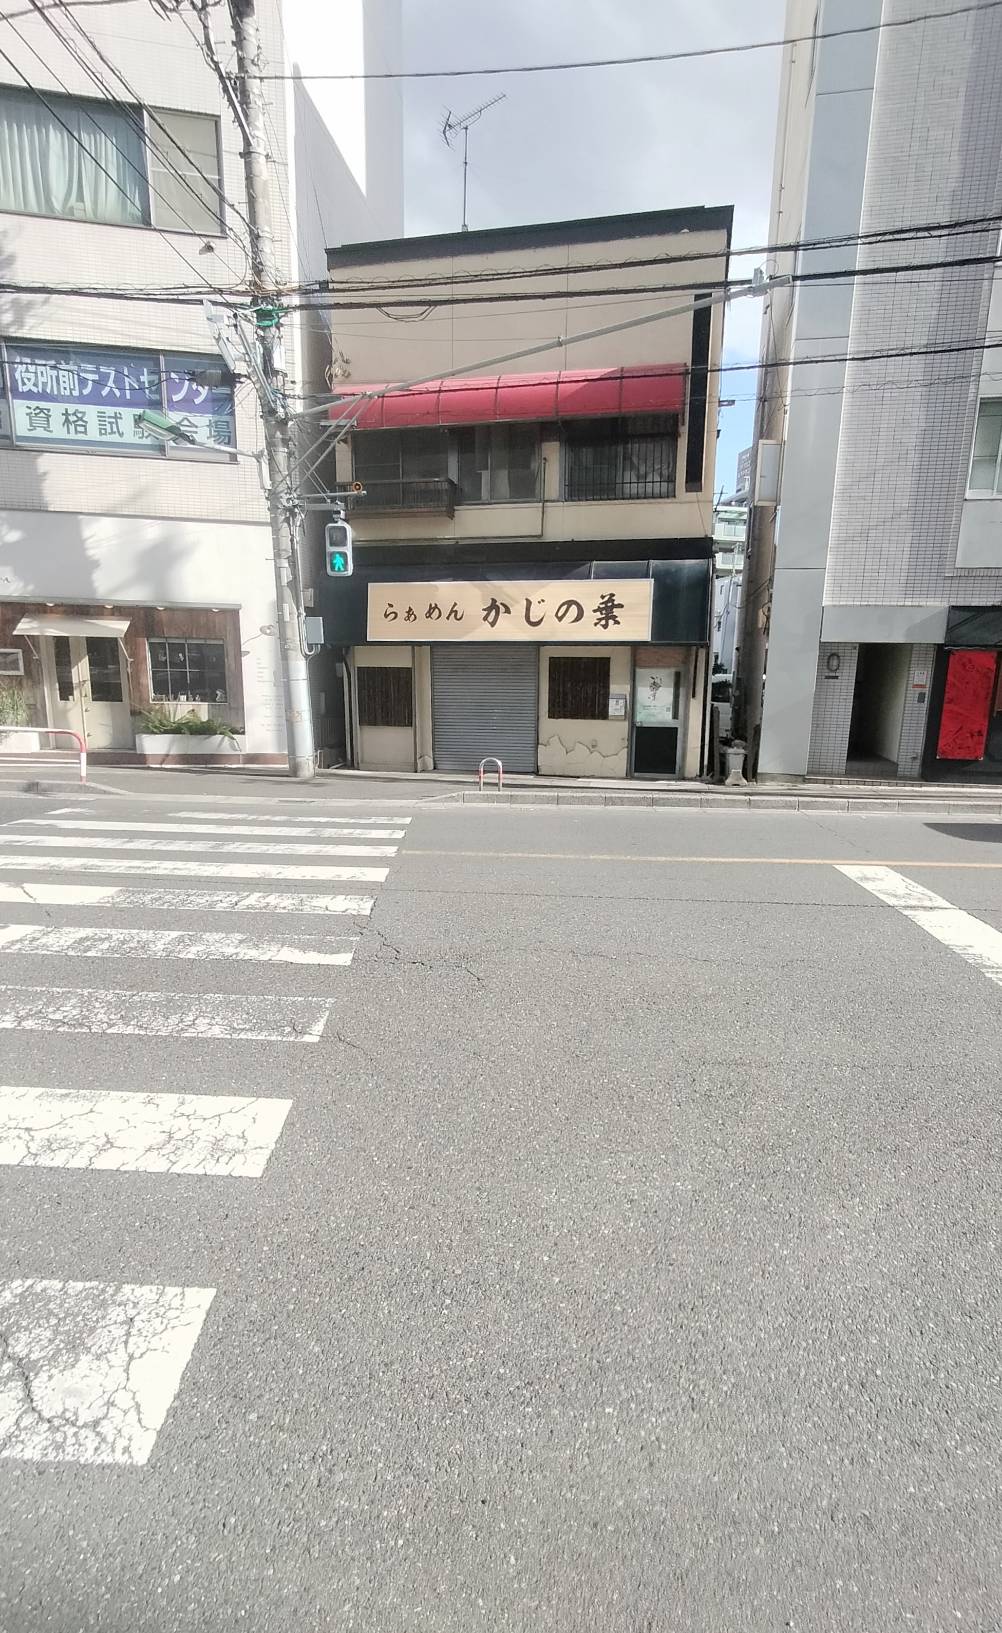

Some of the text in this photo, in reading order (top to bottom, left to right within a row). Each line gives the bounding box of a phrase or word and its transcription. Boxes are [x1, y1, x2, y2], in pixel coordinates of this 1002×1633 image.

[383, 592, 624, 629] らぁめん かじの葉
